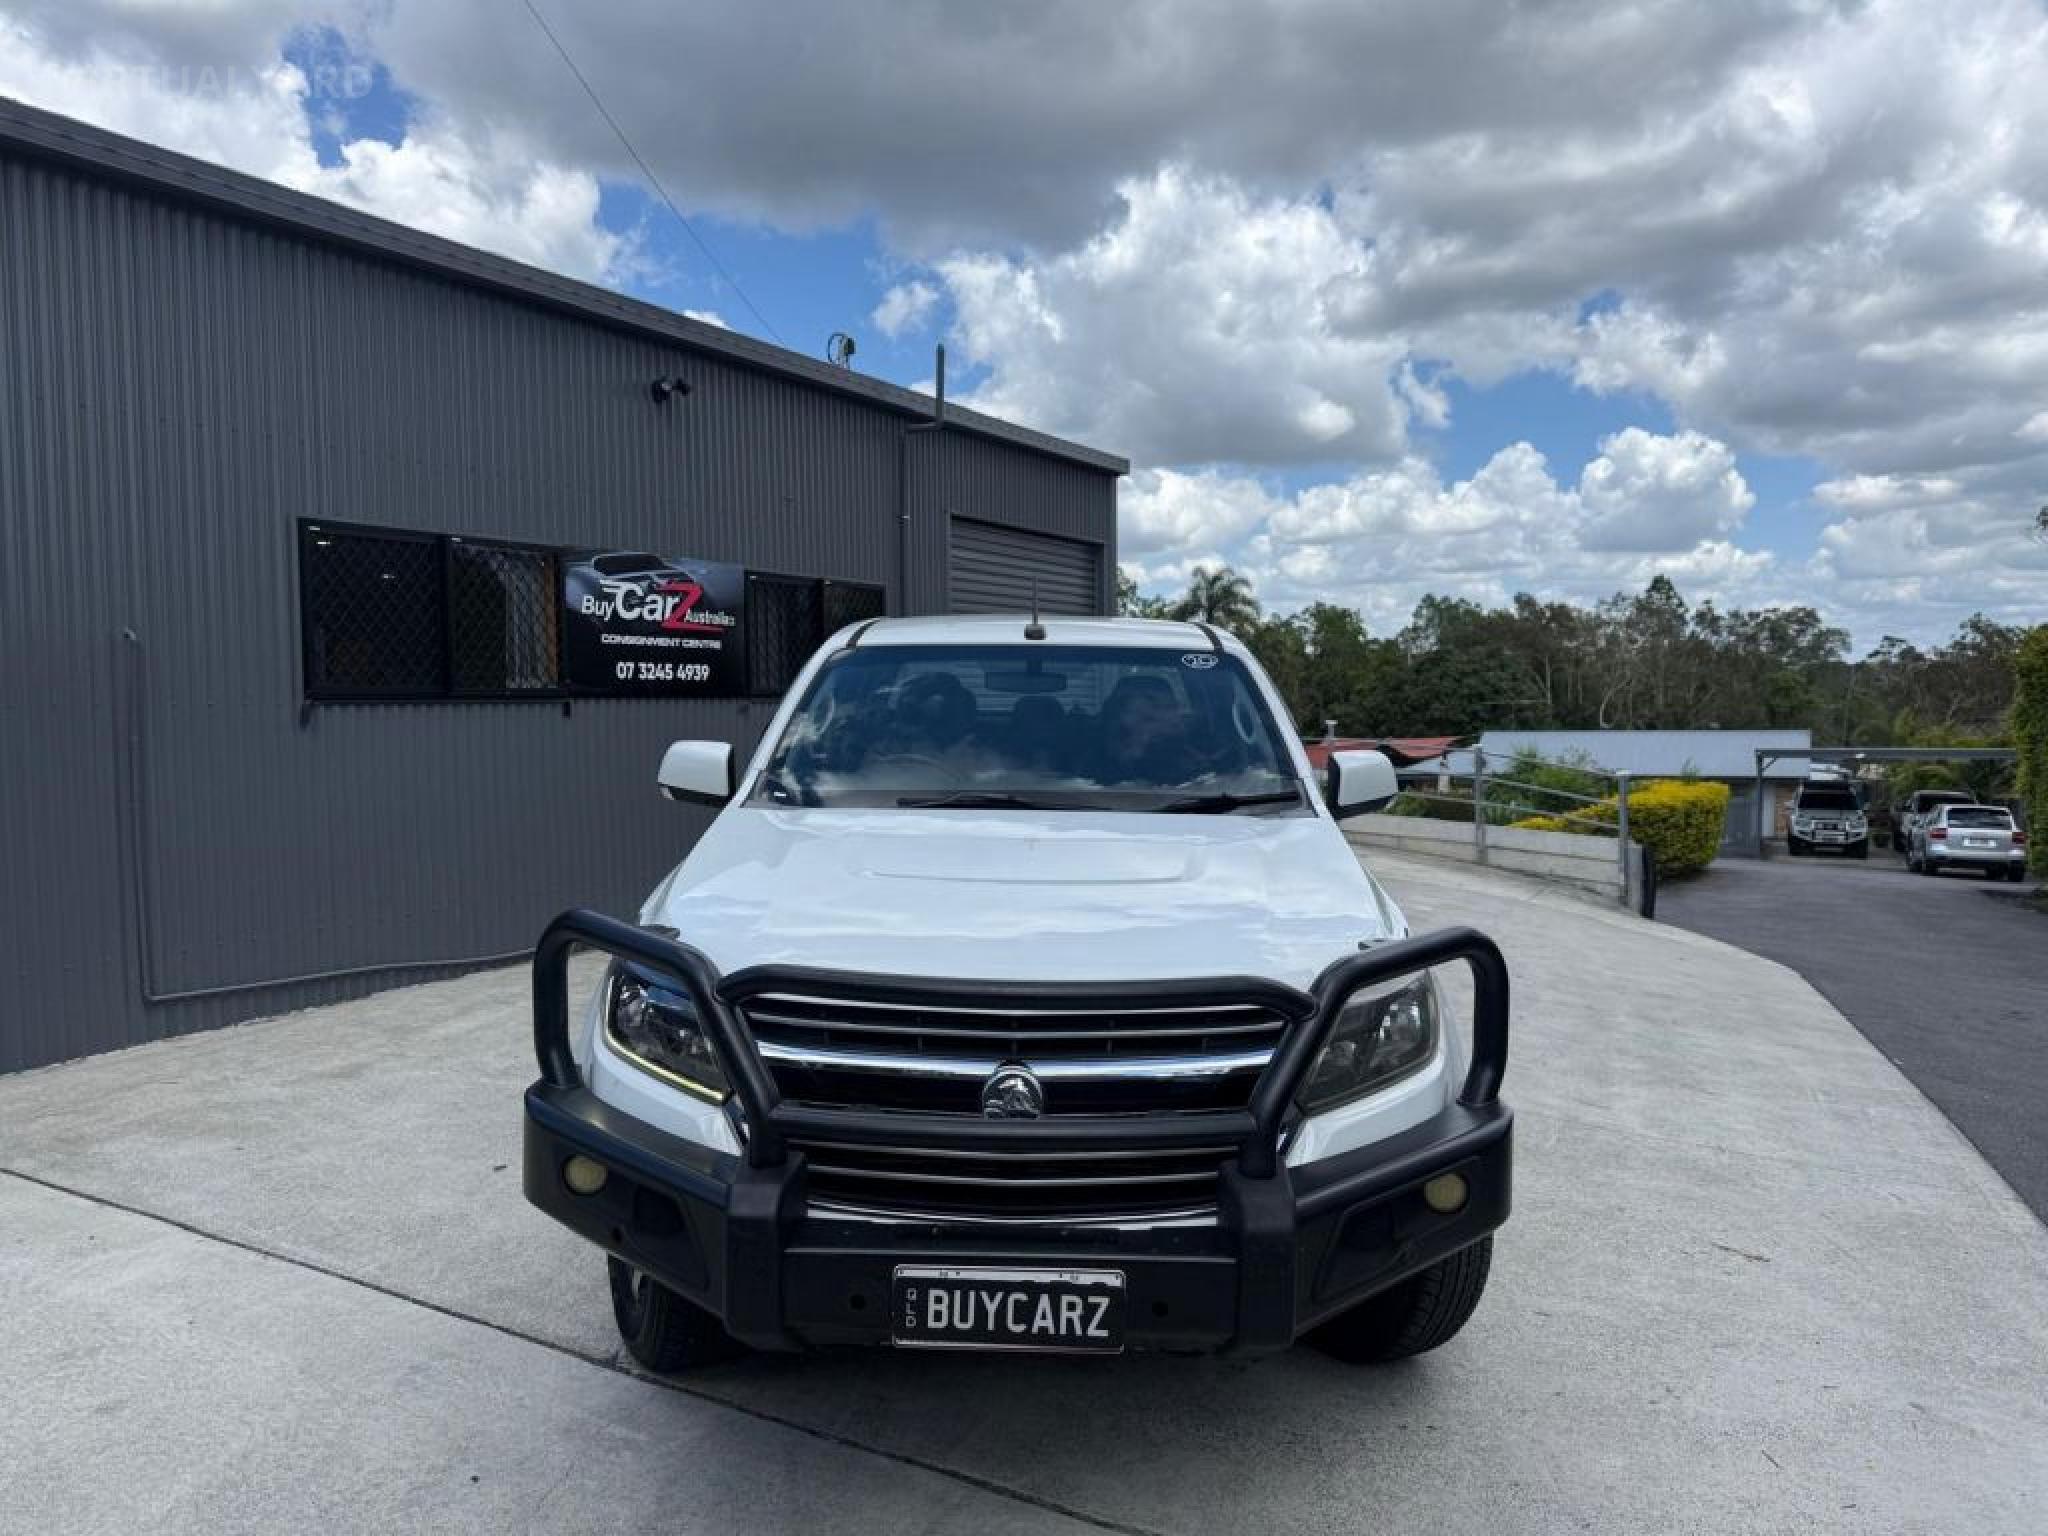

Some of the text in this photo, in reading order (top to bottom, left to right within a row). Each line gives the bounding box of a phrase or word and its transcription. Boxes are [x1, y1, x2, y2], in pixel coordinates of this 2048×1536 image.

[602, 634, 680, 646] CONSIGNMENT
[616, 661, 710, 681] 07 3245 4939
[927, 1288, 1111, 1337] BUYCARZ
